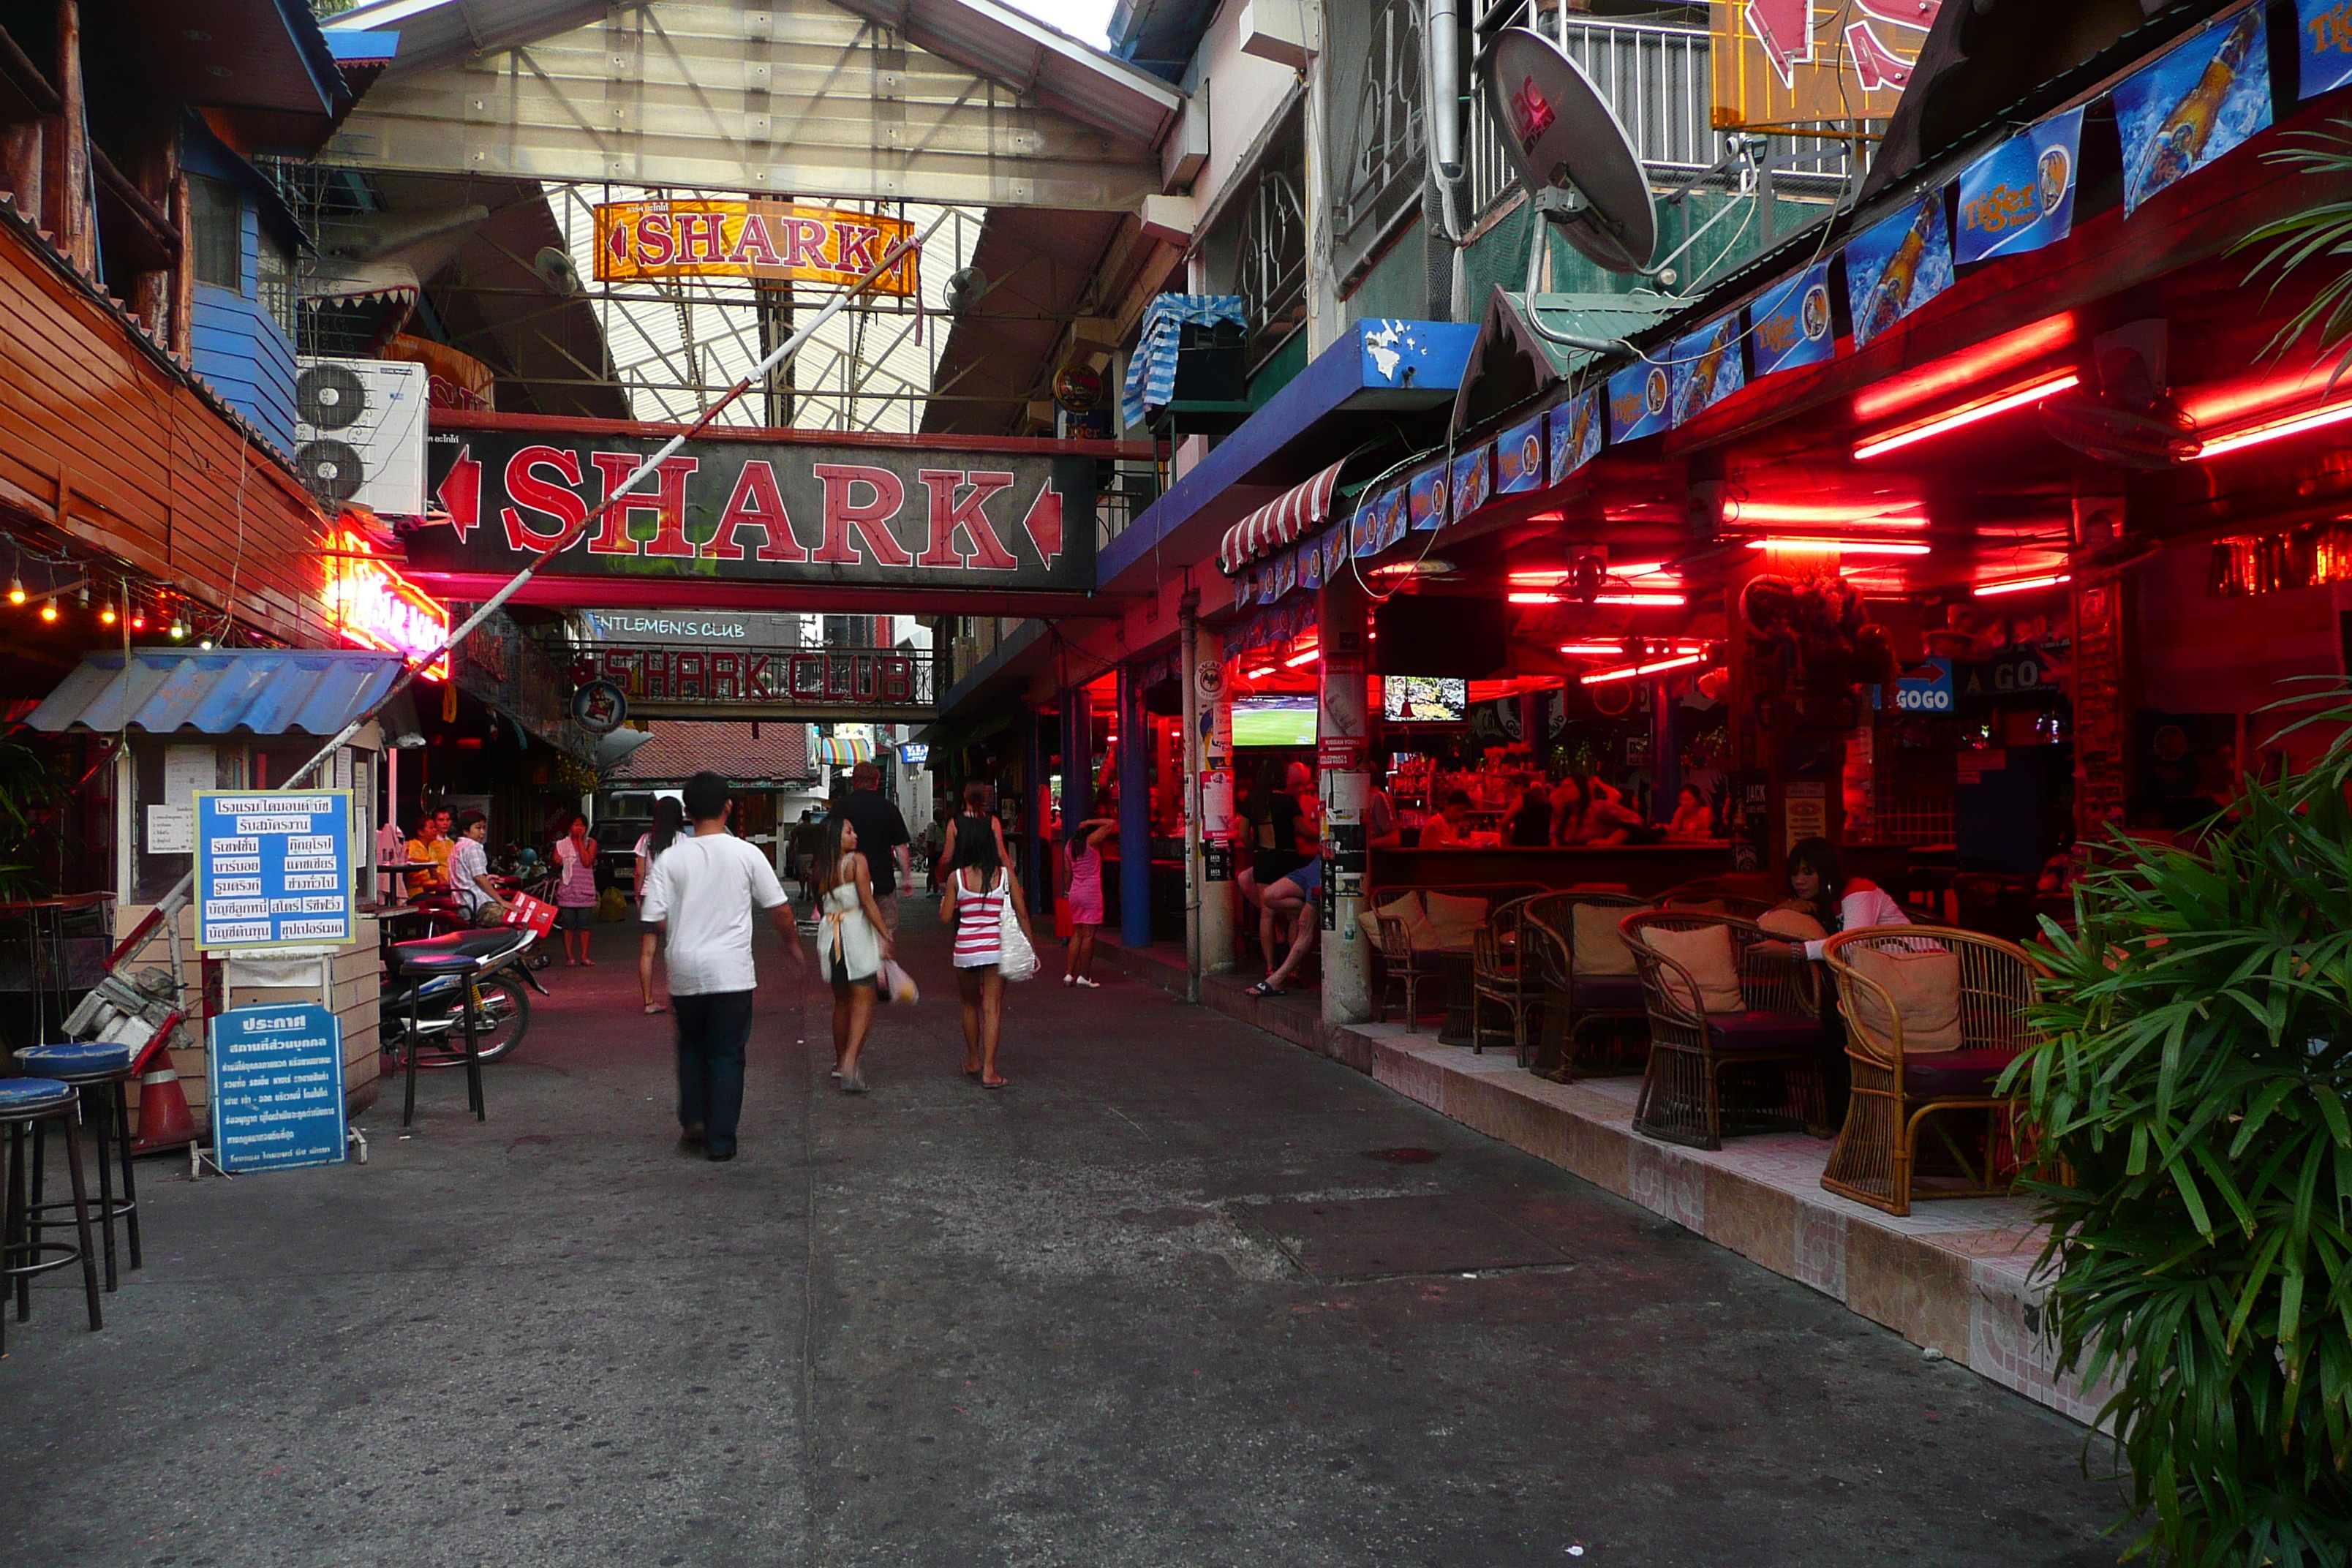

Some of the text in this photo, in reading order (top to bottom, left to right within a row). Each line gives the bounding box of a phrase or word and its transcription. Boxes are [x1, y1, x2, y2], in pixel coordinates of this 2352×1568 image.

[1963, 183, 2035, 232] Tiger
[636, 214, 879, 277] SHARK
[1756, 313, 1797, 353] Tiger
[1060, 423, 1100, 440] Tiger
[501, 445, 1018, 570] SHARK
[701, 622, 745, 638] CLUB
[604, 648, 911, 703] SHARK CLUB
[1994, 660, 2038, 690] GO
[1896, 691, 1948, 708] GOGO
[1746, 784, 1765, 803] JACK
[217, 799, 260, 813] โรงแรม
[240, 818, 308, 832] รับสมัครงาน
[215, 859, 258, 872] บาร์บอย
[288, 875, 333, 889] ช่างทั่วไป
[208, 900, 267, 917] บัญชีลูกหนี้
[208, 924, 269, 940] บัญชีต้นทุน
[243, 1015, 306, 1030] ประกาศ
[230, 1037, 327, 1053] สถานที่ส่วนบุคคล
